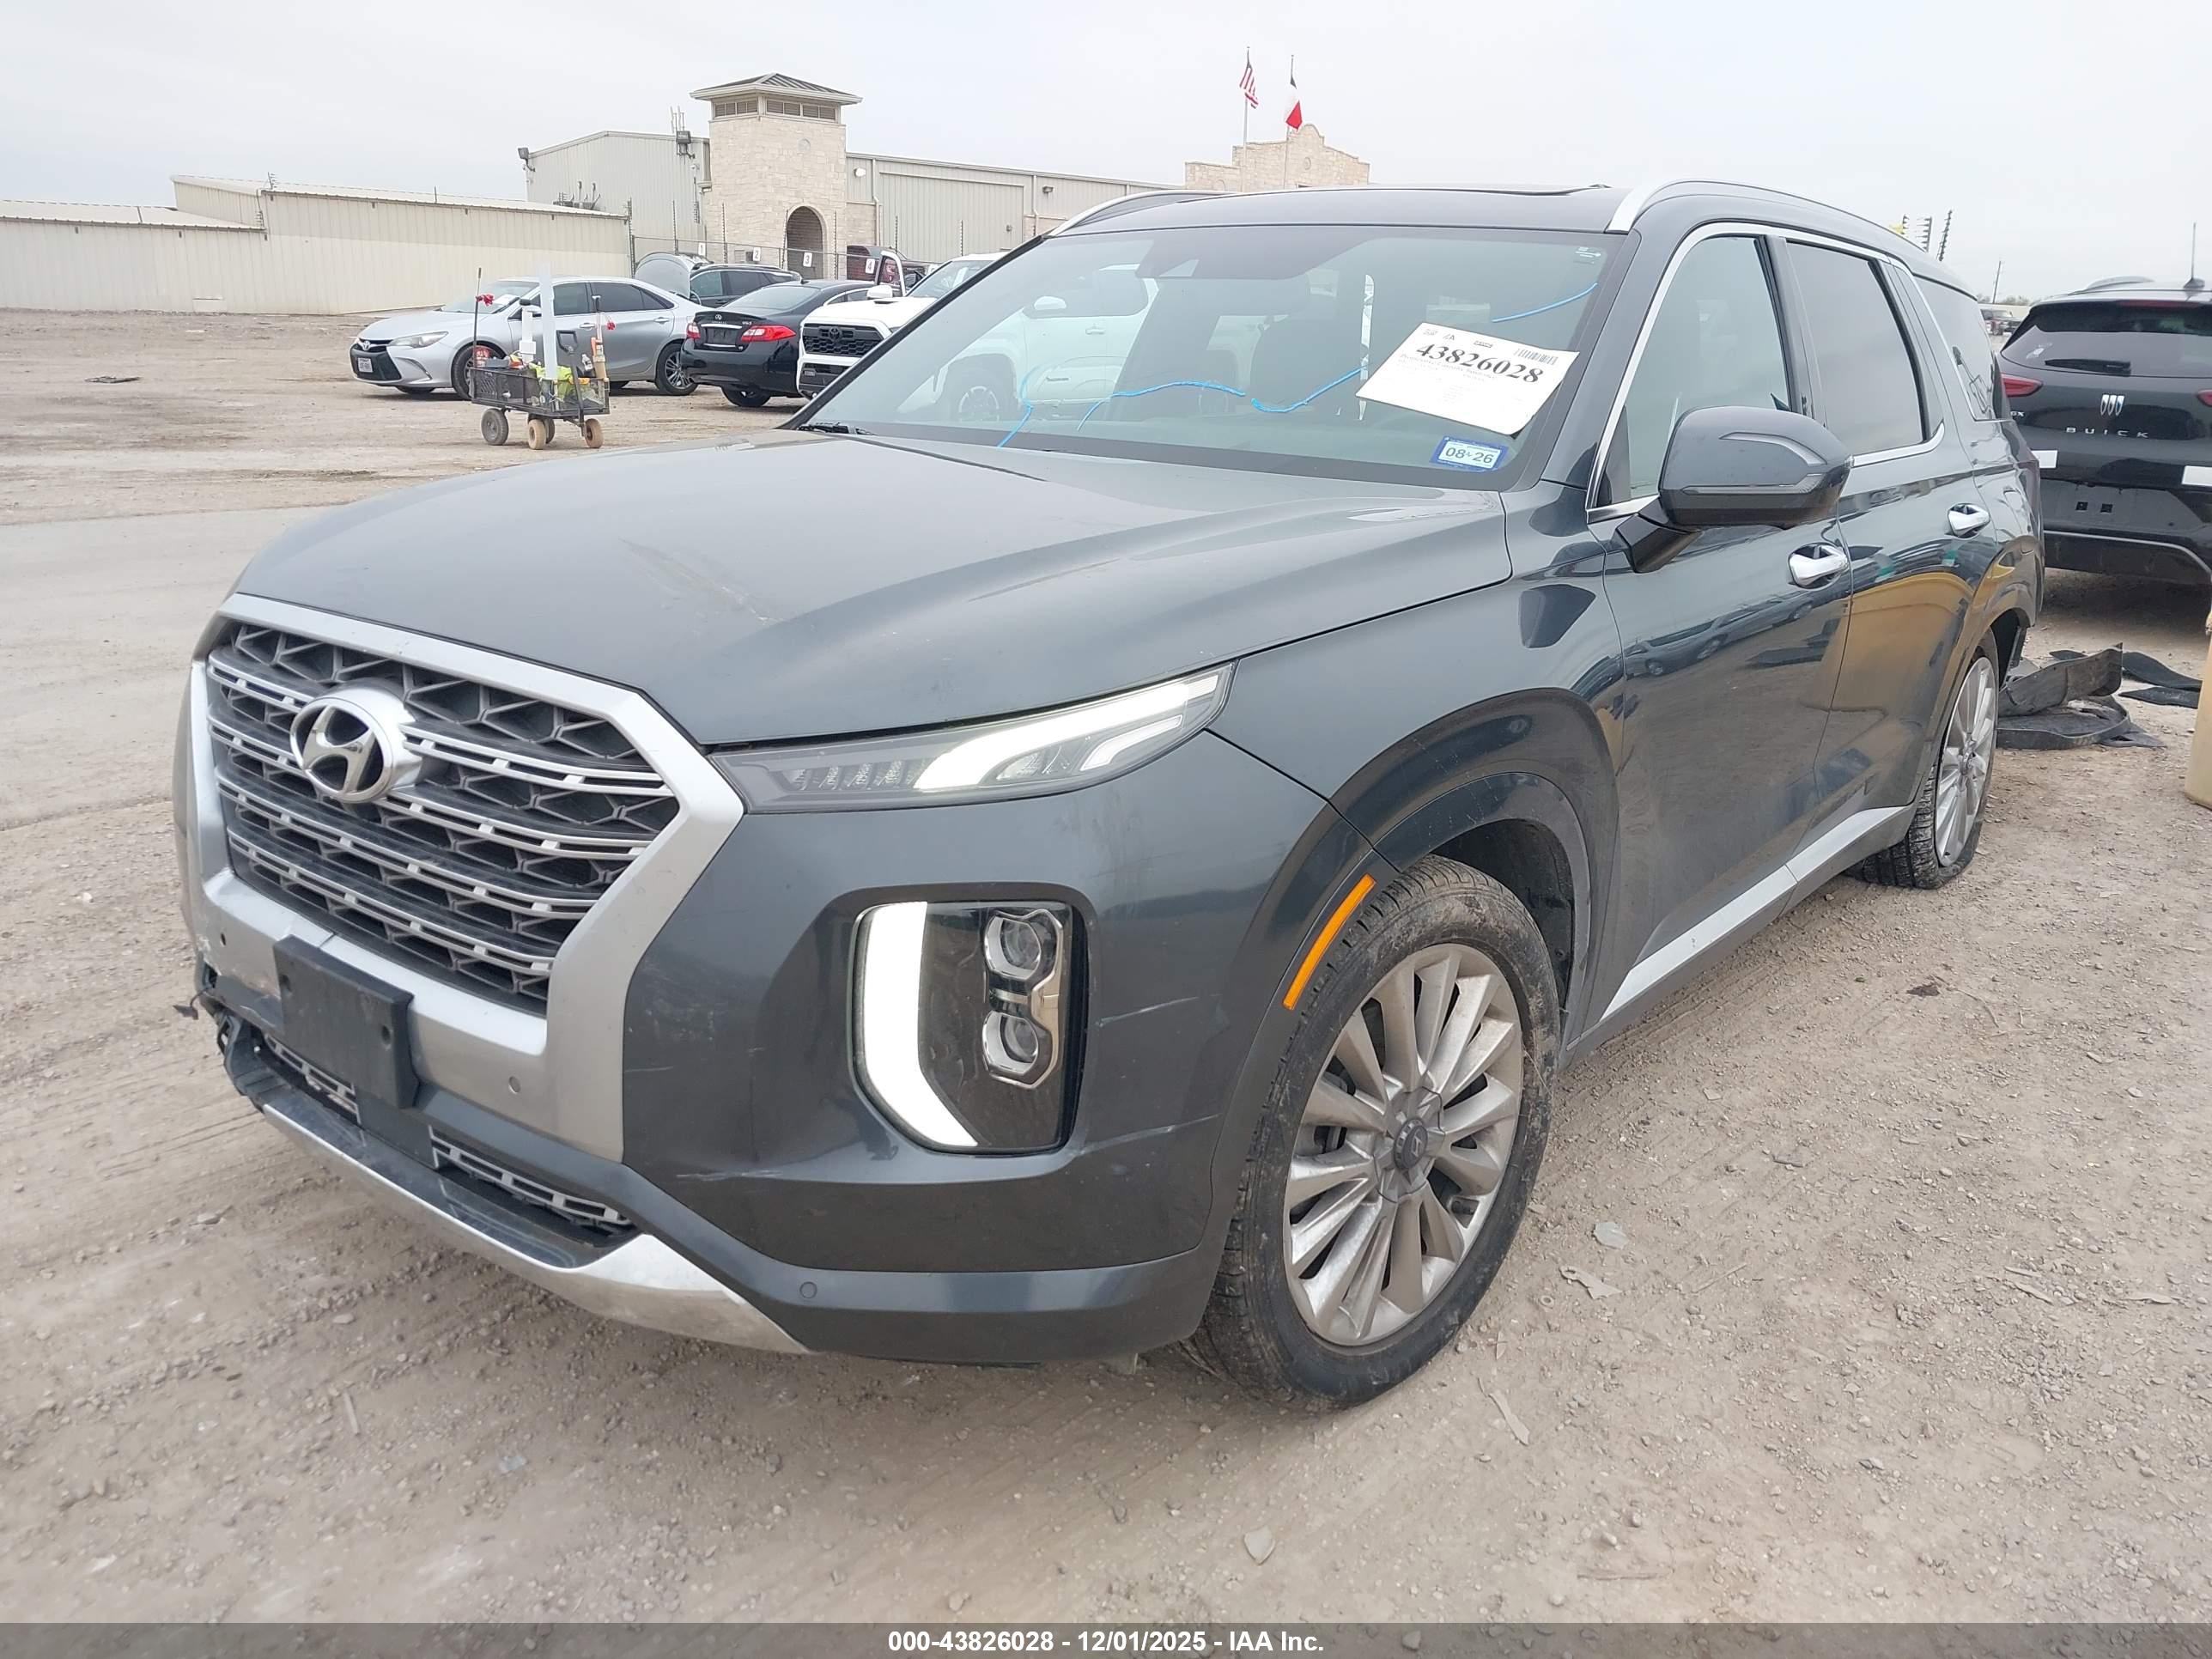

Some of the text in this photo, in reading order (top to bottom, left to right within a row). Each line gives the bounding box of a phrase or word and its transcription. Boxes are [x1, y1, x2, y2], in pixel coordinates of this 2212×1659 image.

[1416, 343, 1544, 383] 43826028
[2065, 427, 2149, 439] BUICK
[1445, 447, 1467, 459] 08
[1472, 452, 1494, 464] 26
